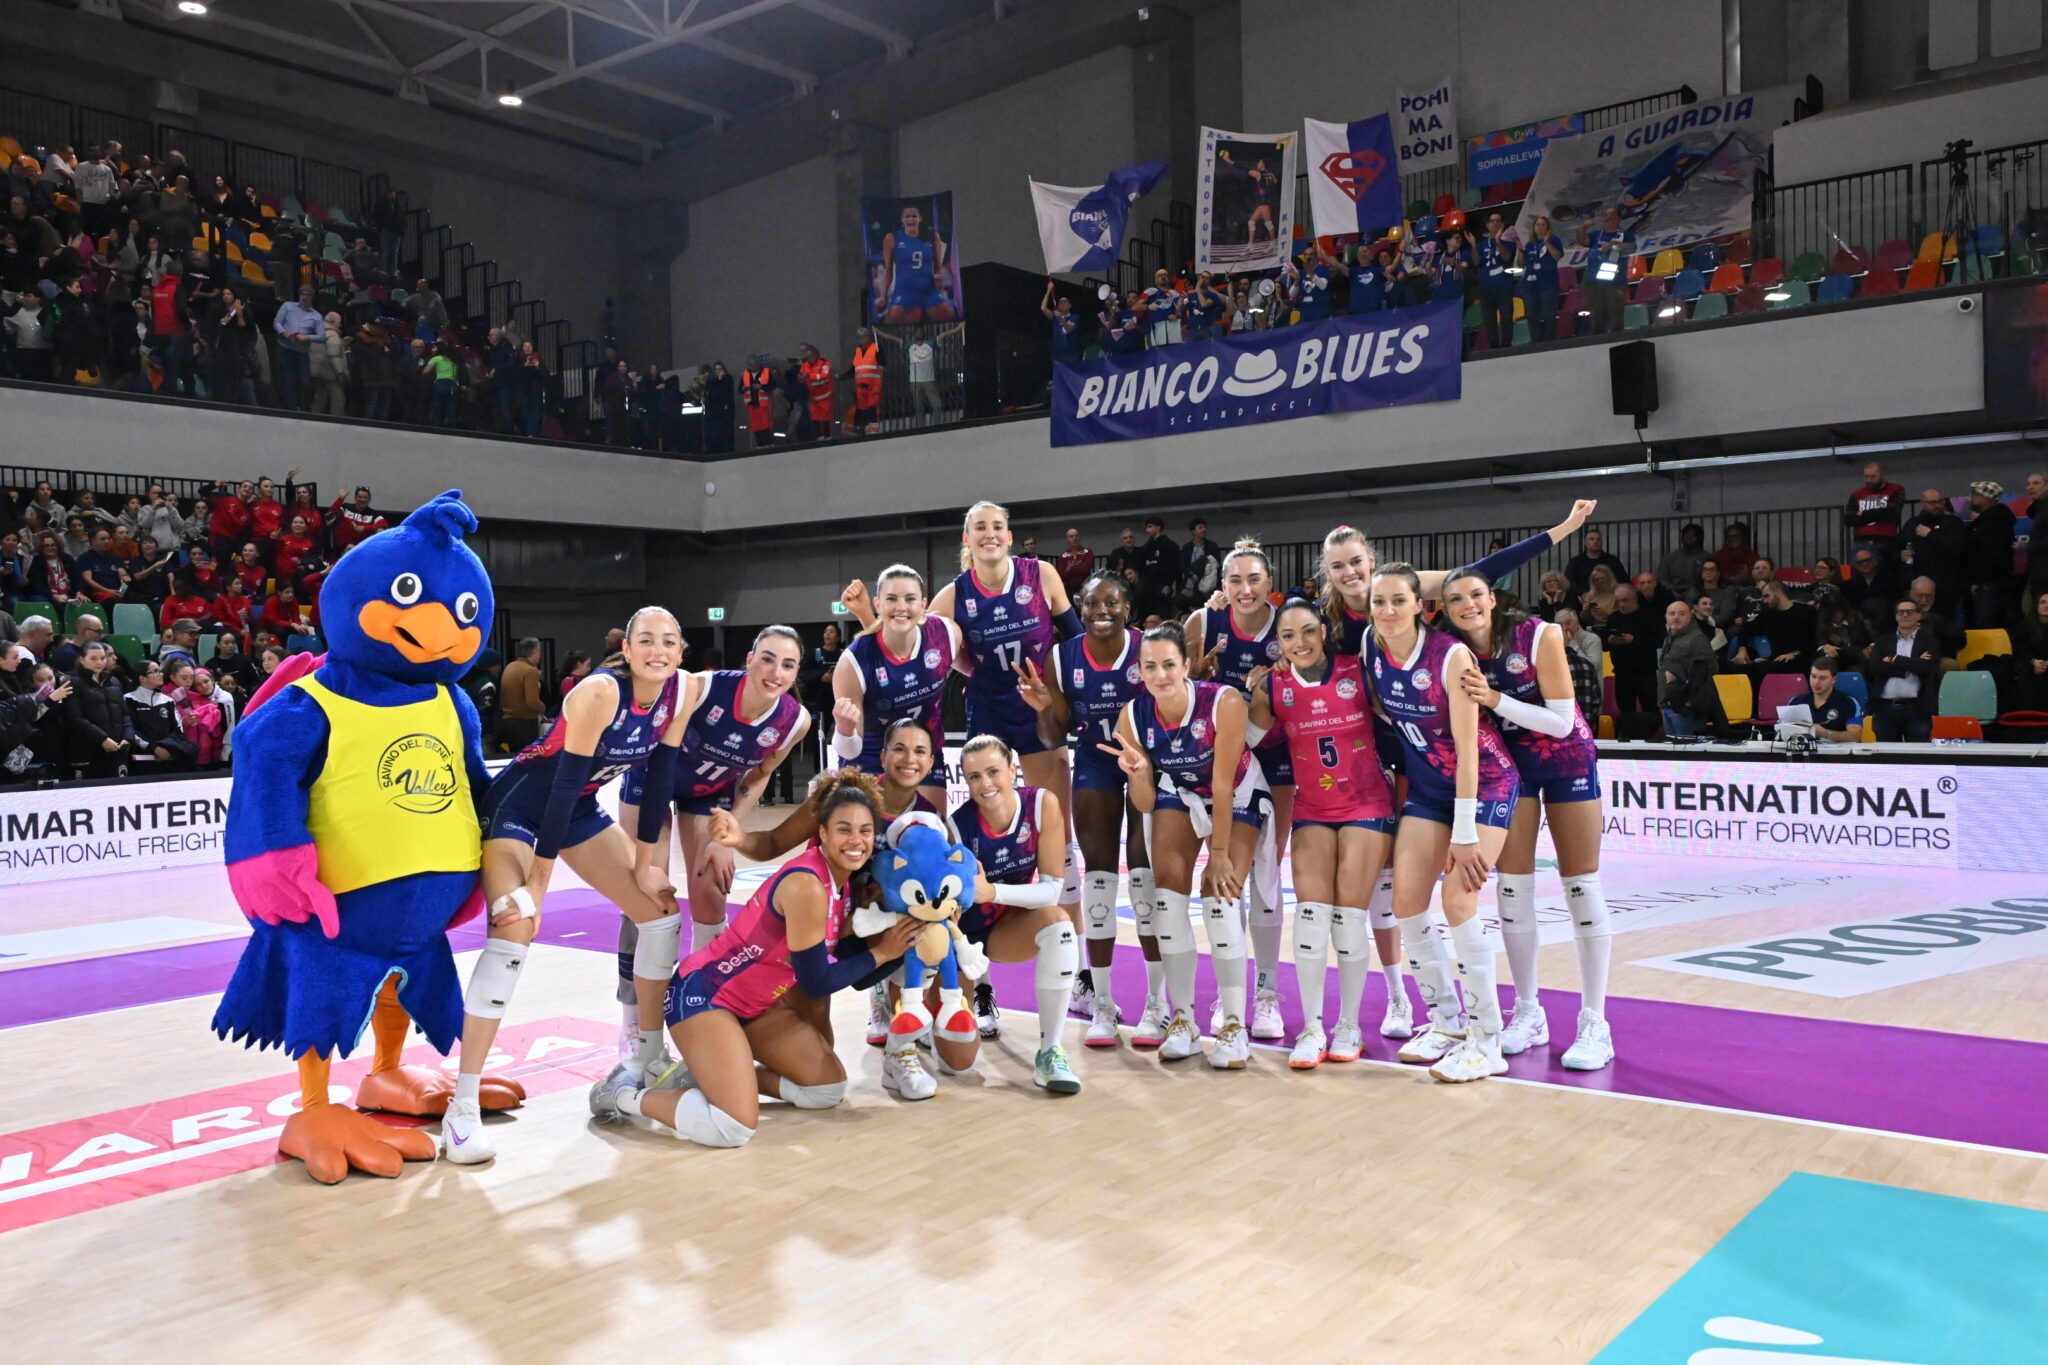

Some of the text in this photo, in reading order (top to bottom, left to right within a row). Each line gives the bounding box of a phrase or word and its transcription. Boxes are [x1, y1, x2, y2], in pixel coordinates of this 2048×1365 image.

[1408, 113, 1443, 136] MA
[1597, 97, 1754, 158] A GUARDIA
[1200, 130, 1214, 264] ANTROPOVA
[911, 251, 923, 270] 9
[1076, 324, 1430, 420] BIANCO BLUES
[1170, 398, 1312, 426] SCANDICCI
[983, 616, 1041, 636] SAVINO DEL BENE
[993, 640, 1021, 671] 17
[894, 691, 918, 703] SAVINO
[918, 686, 931, 695] DEL
[1299, 712, 1365, 729] SAVINO DEL BENE
[1397, 720, 1428, 748] 10
[382, 739, 450, 788] SAVINO DEL BENE
[703, 743, 731, 758] SAVINO
[731, 755, 745, 764] DEL
[1317, 735, 1340, 769] 5
[695, 760, 729, 780] 11
[1611, 780, 1946, 819] INTERNATIONAL
[1643, 817, 1748, 842] FREIGHT
[1756, 821, 1951, 850] FORWARDERS
